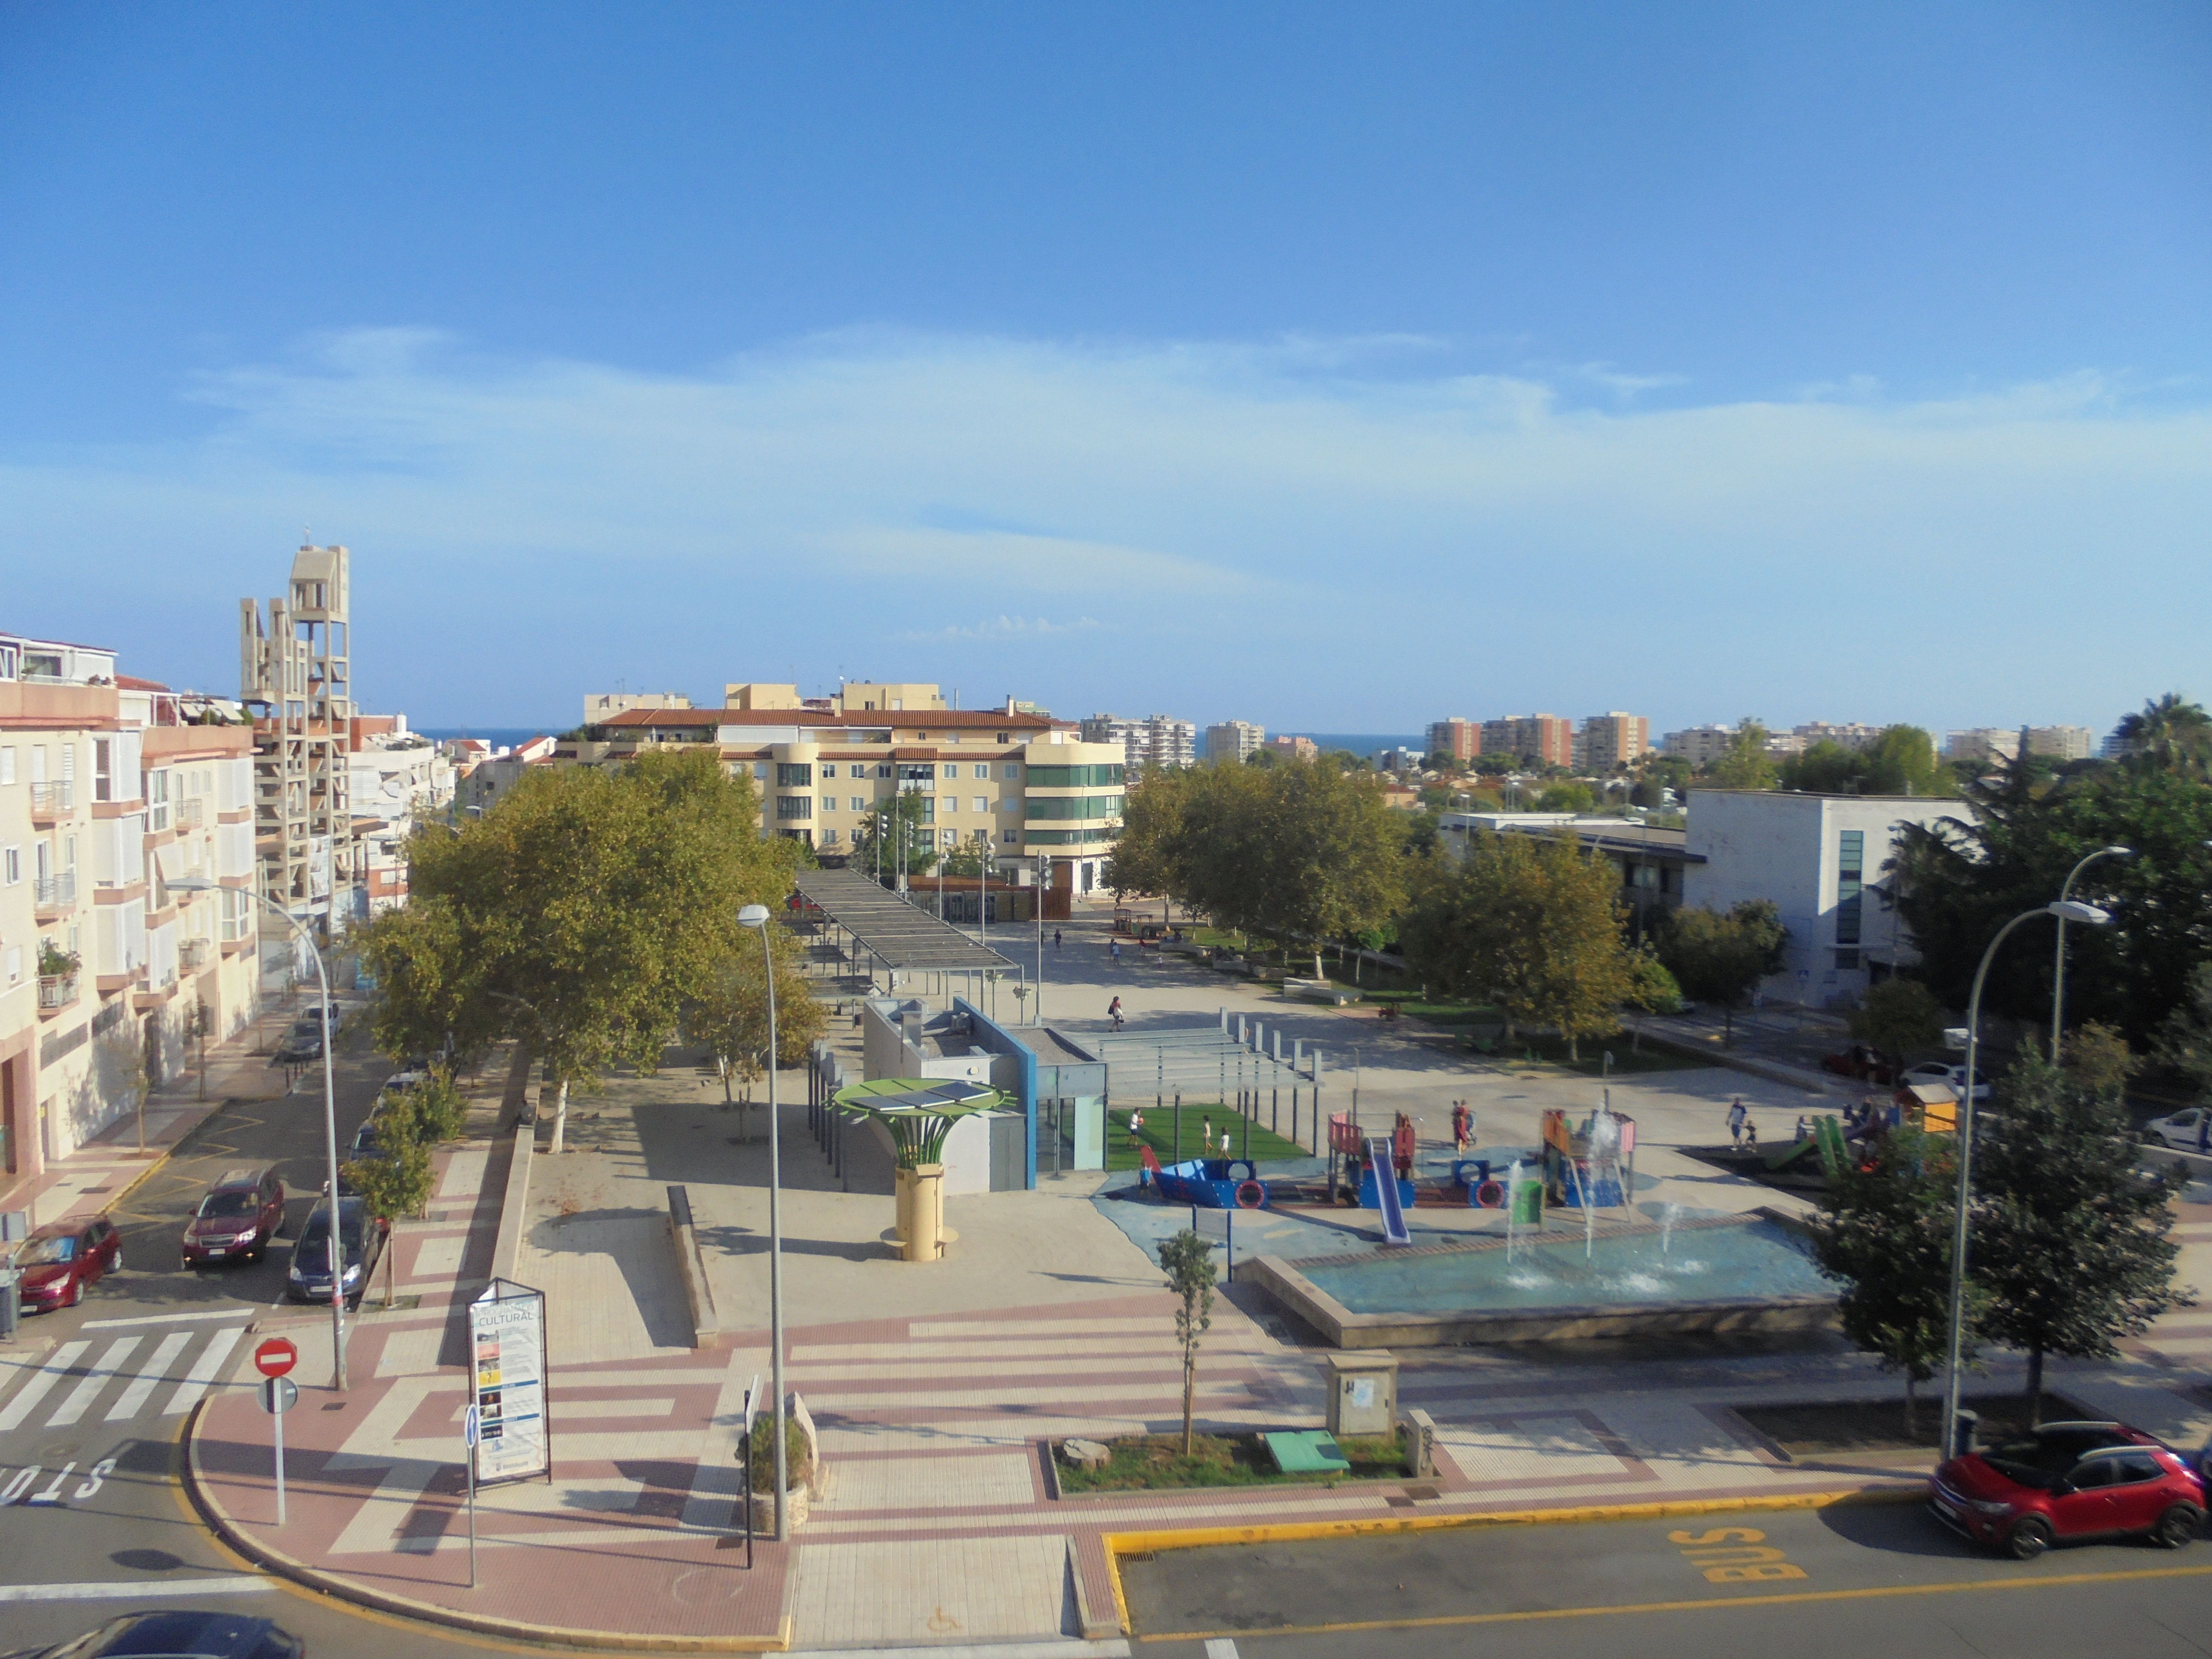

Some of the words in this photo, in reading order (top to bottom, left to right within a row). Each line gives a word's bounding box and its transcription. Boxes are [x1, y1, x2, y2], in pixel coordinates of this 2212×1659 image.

[479, 1312, 534, 1326] CULTURAL
[0, 1458, 117, 1505] STO
[1668, 1527, 1808, 1583] BUS
